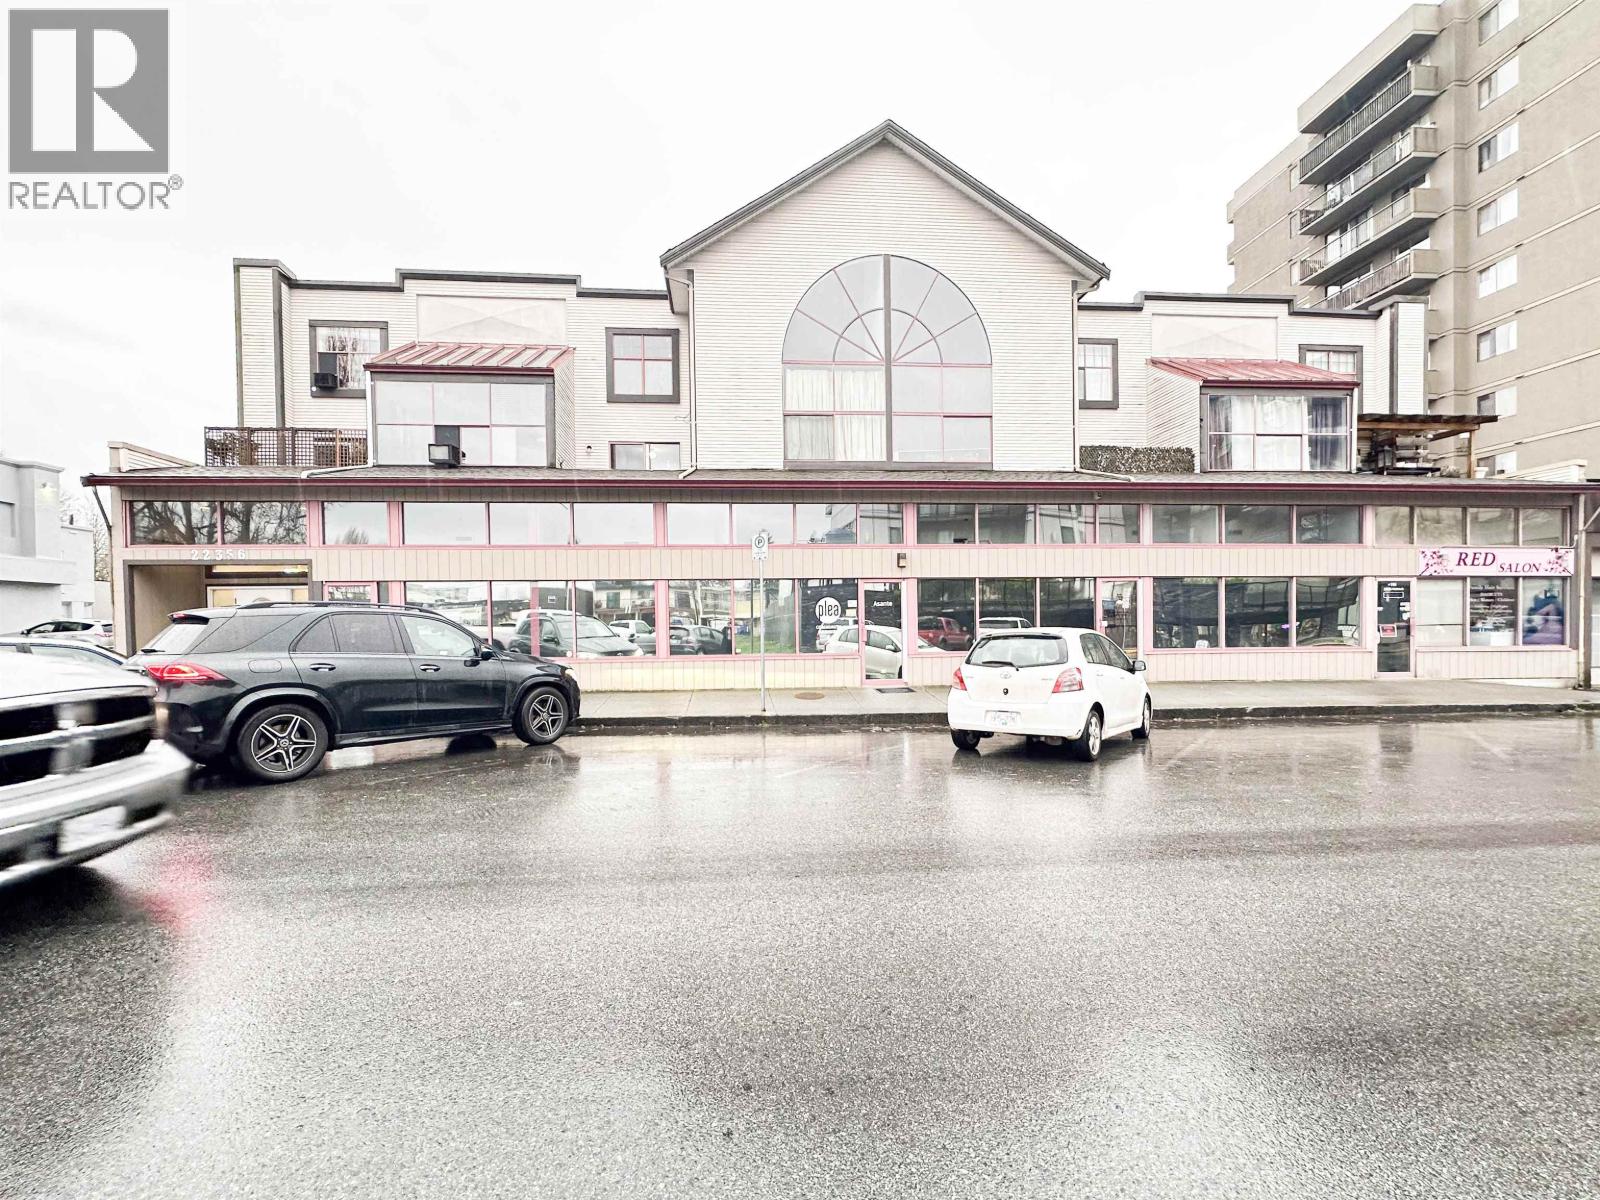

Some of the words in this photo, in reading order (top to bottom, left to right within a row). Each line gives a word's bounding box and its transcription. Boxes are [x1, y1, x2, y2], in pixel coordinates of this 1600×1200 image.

[191, 549, 246, 560] 22356
[1455, 552, 1496, 566] RED
[1498, 562, 1541, 573] SALON
[818, 600, 839, 619] plea
